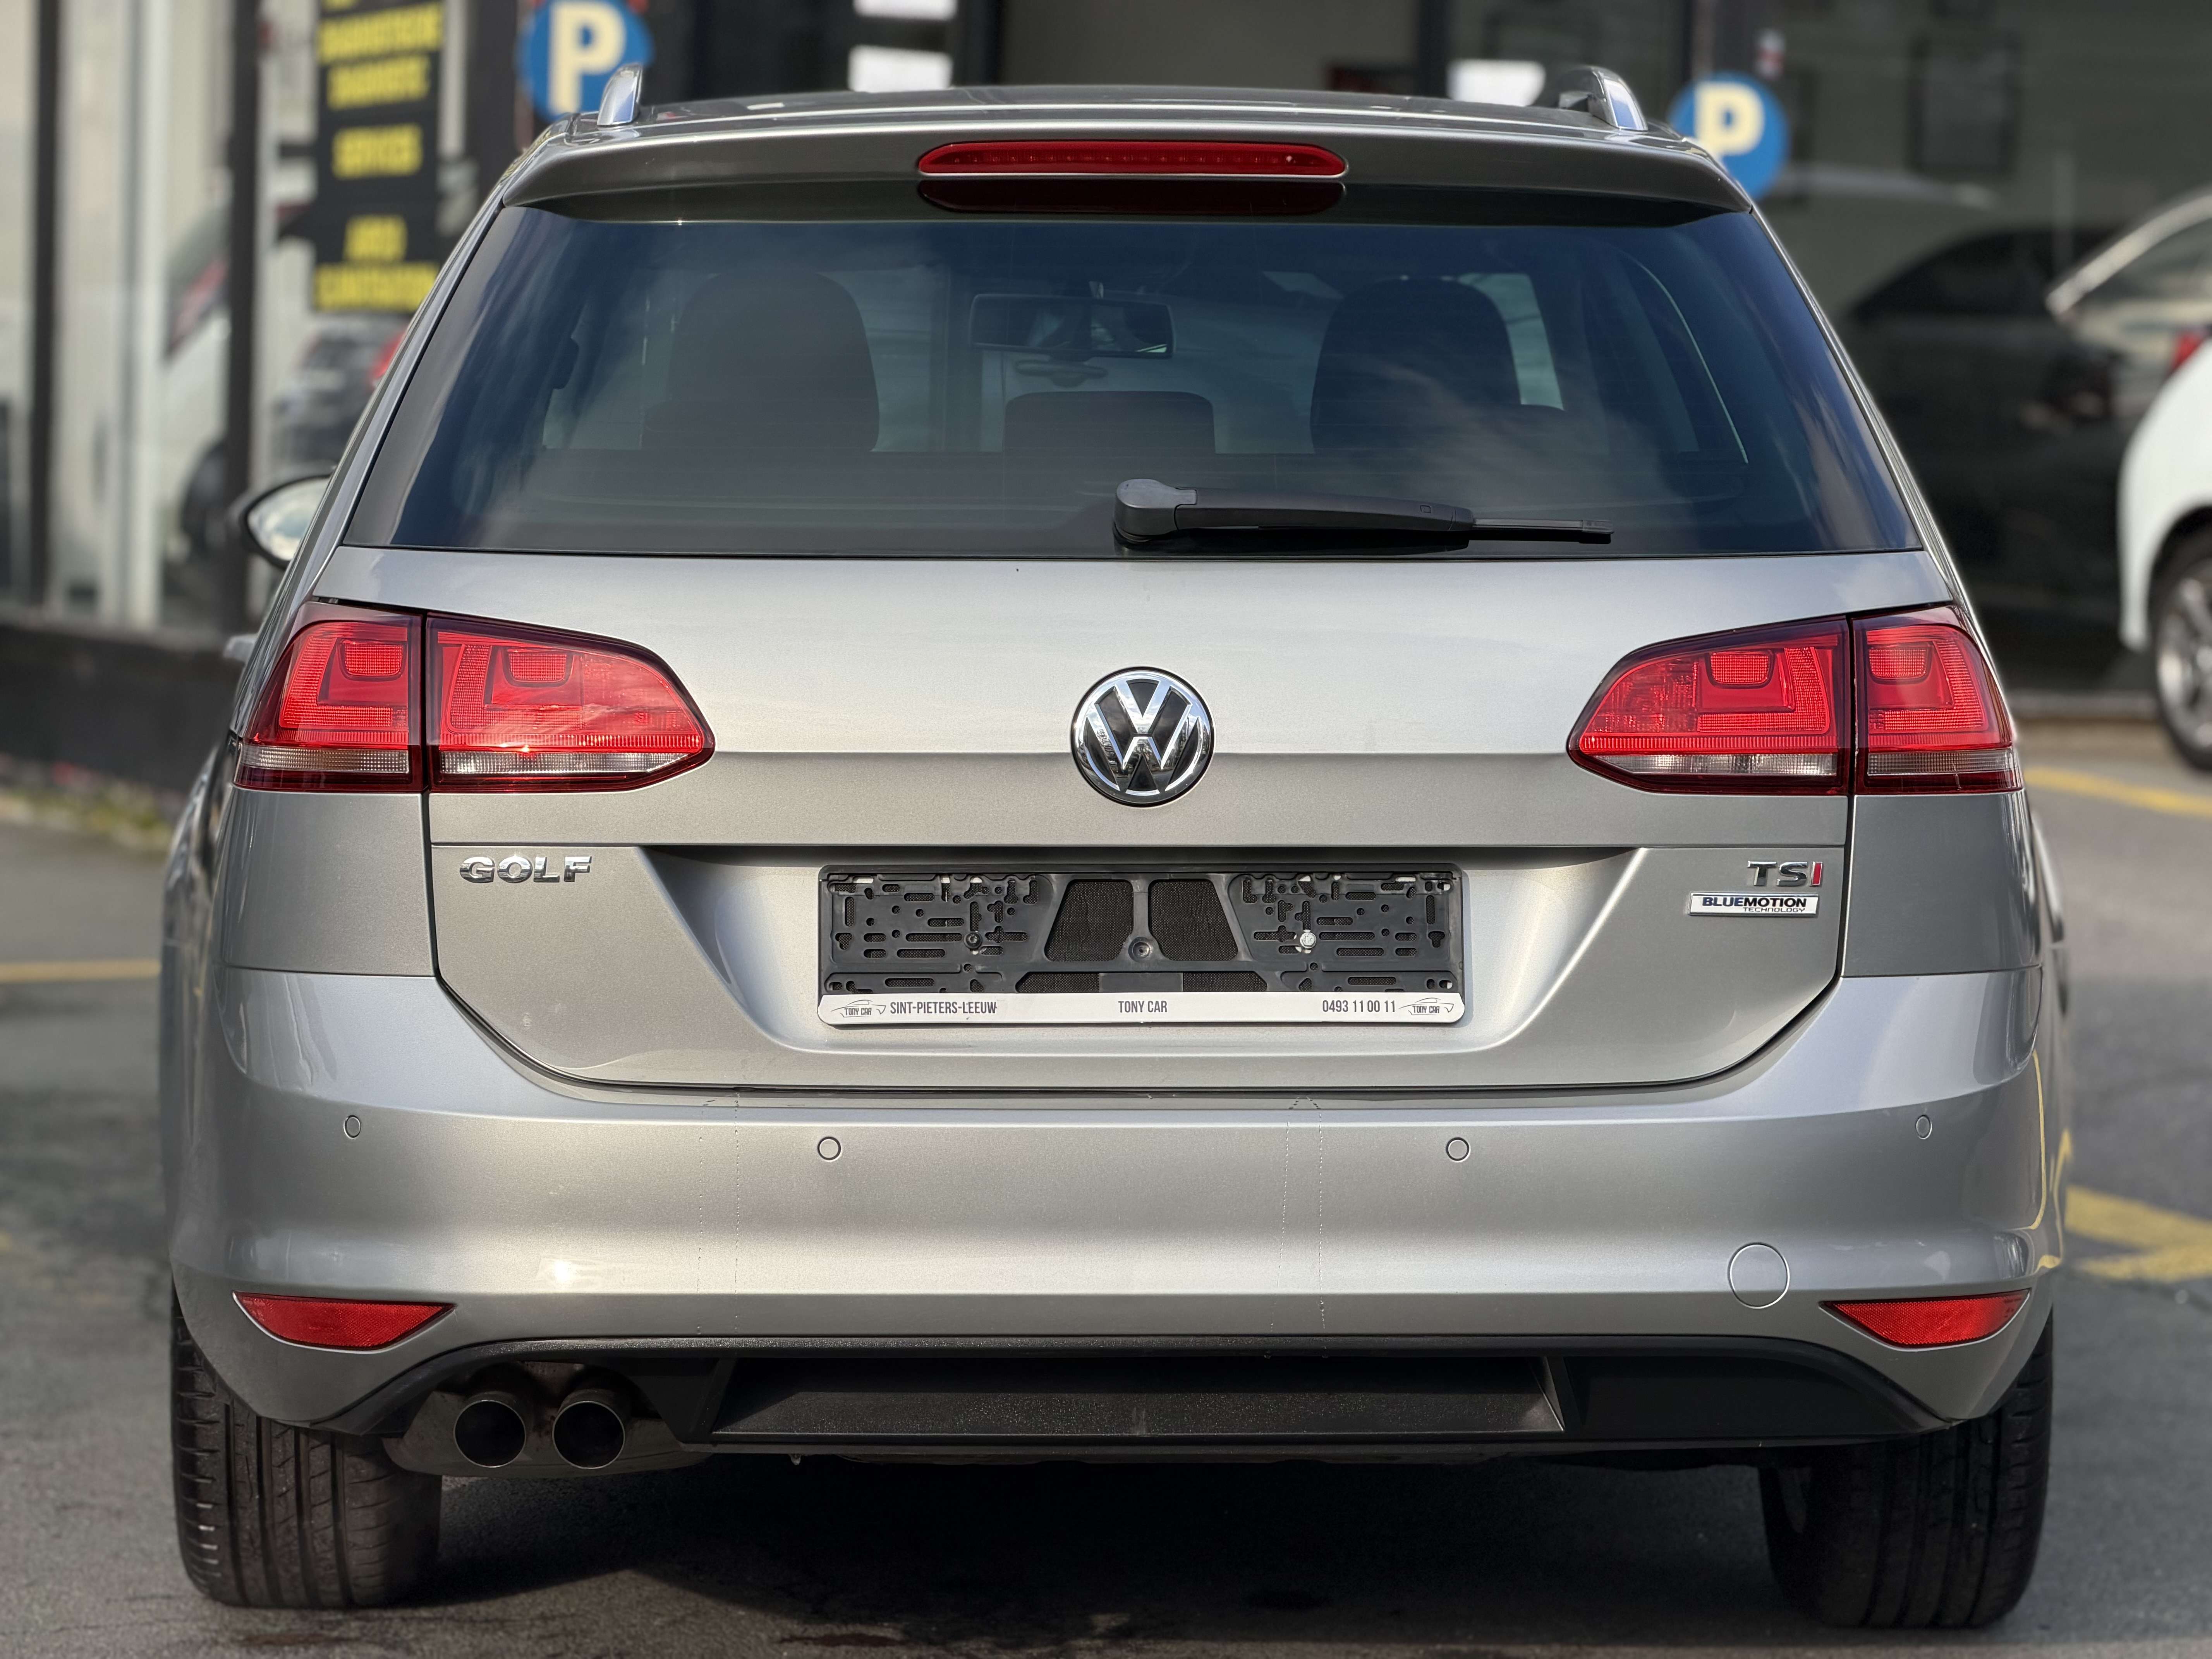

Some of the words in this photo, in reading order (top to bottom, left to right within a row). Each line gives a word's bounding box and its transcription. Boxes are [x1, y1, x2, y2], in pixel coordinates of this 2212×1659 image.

[548, 2, 626, 116] P
[1695, 81, 1764, 163] P
[1072, 668, 1214, 807] VW
[460, 855, 592, 883] GOLF
[1747, 860, 1823, 886] TSI
[1702, 897, 1807, 907] BLUEMOTION
[890, 1001, 997, 1014] SINT-PIETERS-LEEUW
[1118, 1001, 1145, 1013] TONY
[1147, 1000, 1168, 1013] CAR
[1322, 1000, 1349, 1012] 0493
[1352, 1000, 1364, 1012] 11
[1367, 1000, 1380, 1012] 00
[1384, 1000, 1395, 1012] 11
